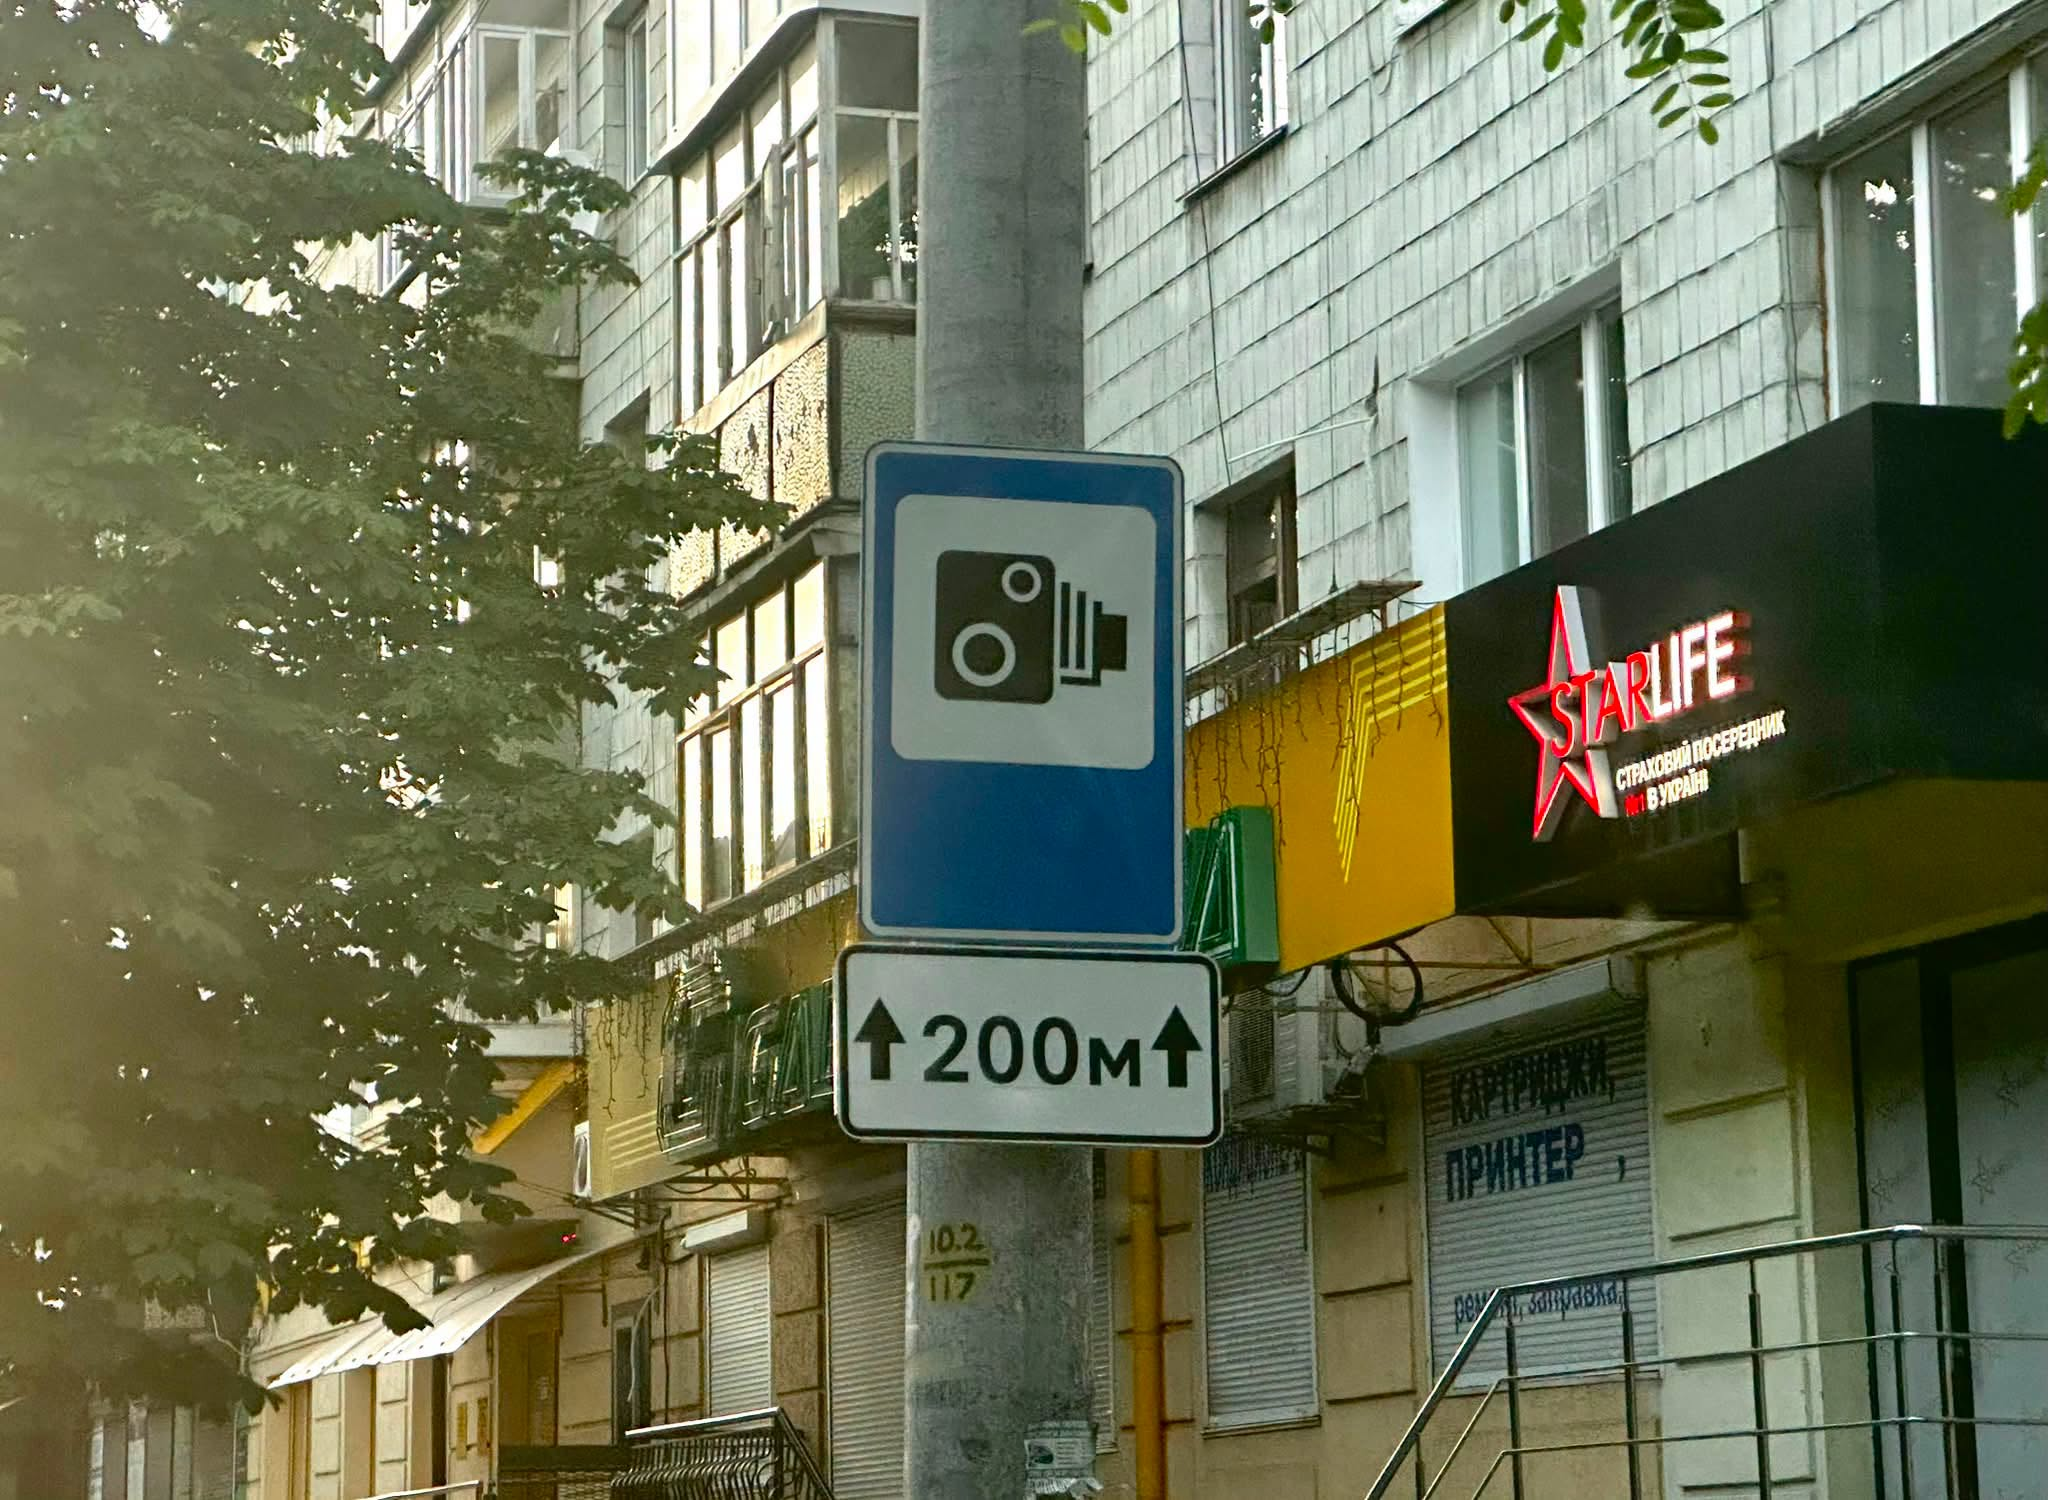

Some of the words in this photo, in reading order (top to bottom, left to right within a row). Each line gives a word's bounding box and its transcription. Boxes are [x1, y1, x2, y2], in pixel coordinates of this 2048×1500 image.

[1550, 611, 1737, 758] STARLIFE
[1615, 742, 1692, 790] СТРАХОВИЙ
[1692, 710, 1786, 764] ПОСЕРЕДНИК
[1659, 768, 1709, 804] УКРАЇНІ
[930, 1272, 975, 1301] 117
